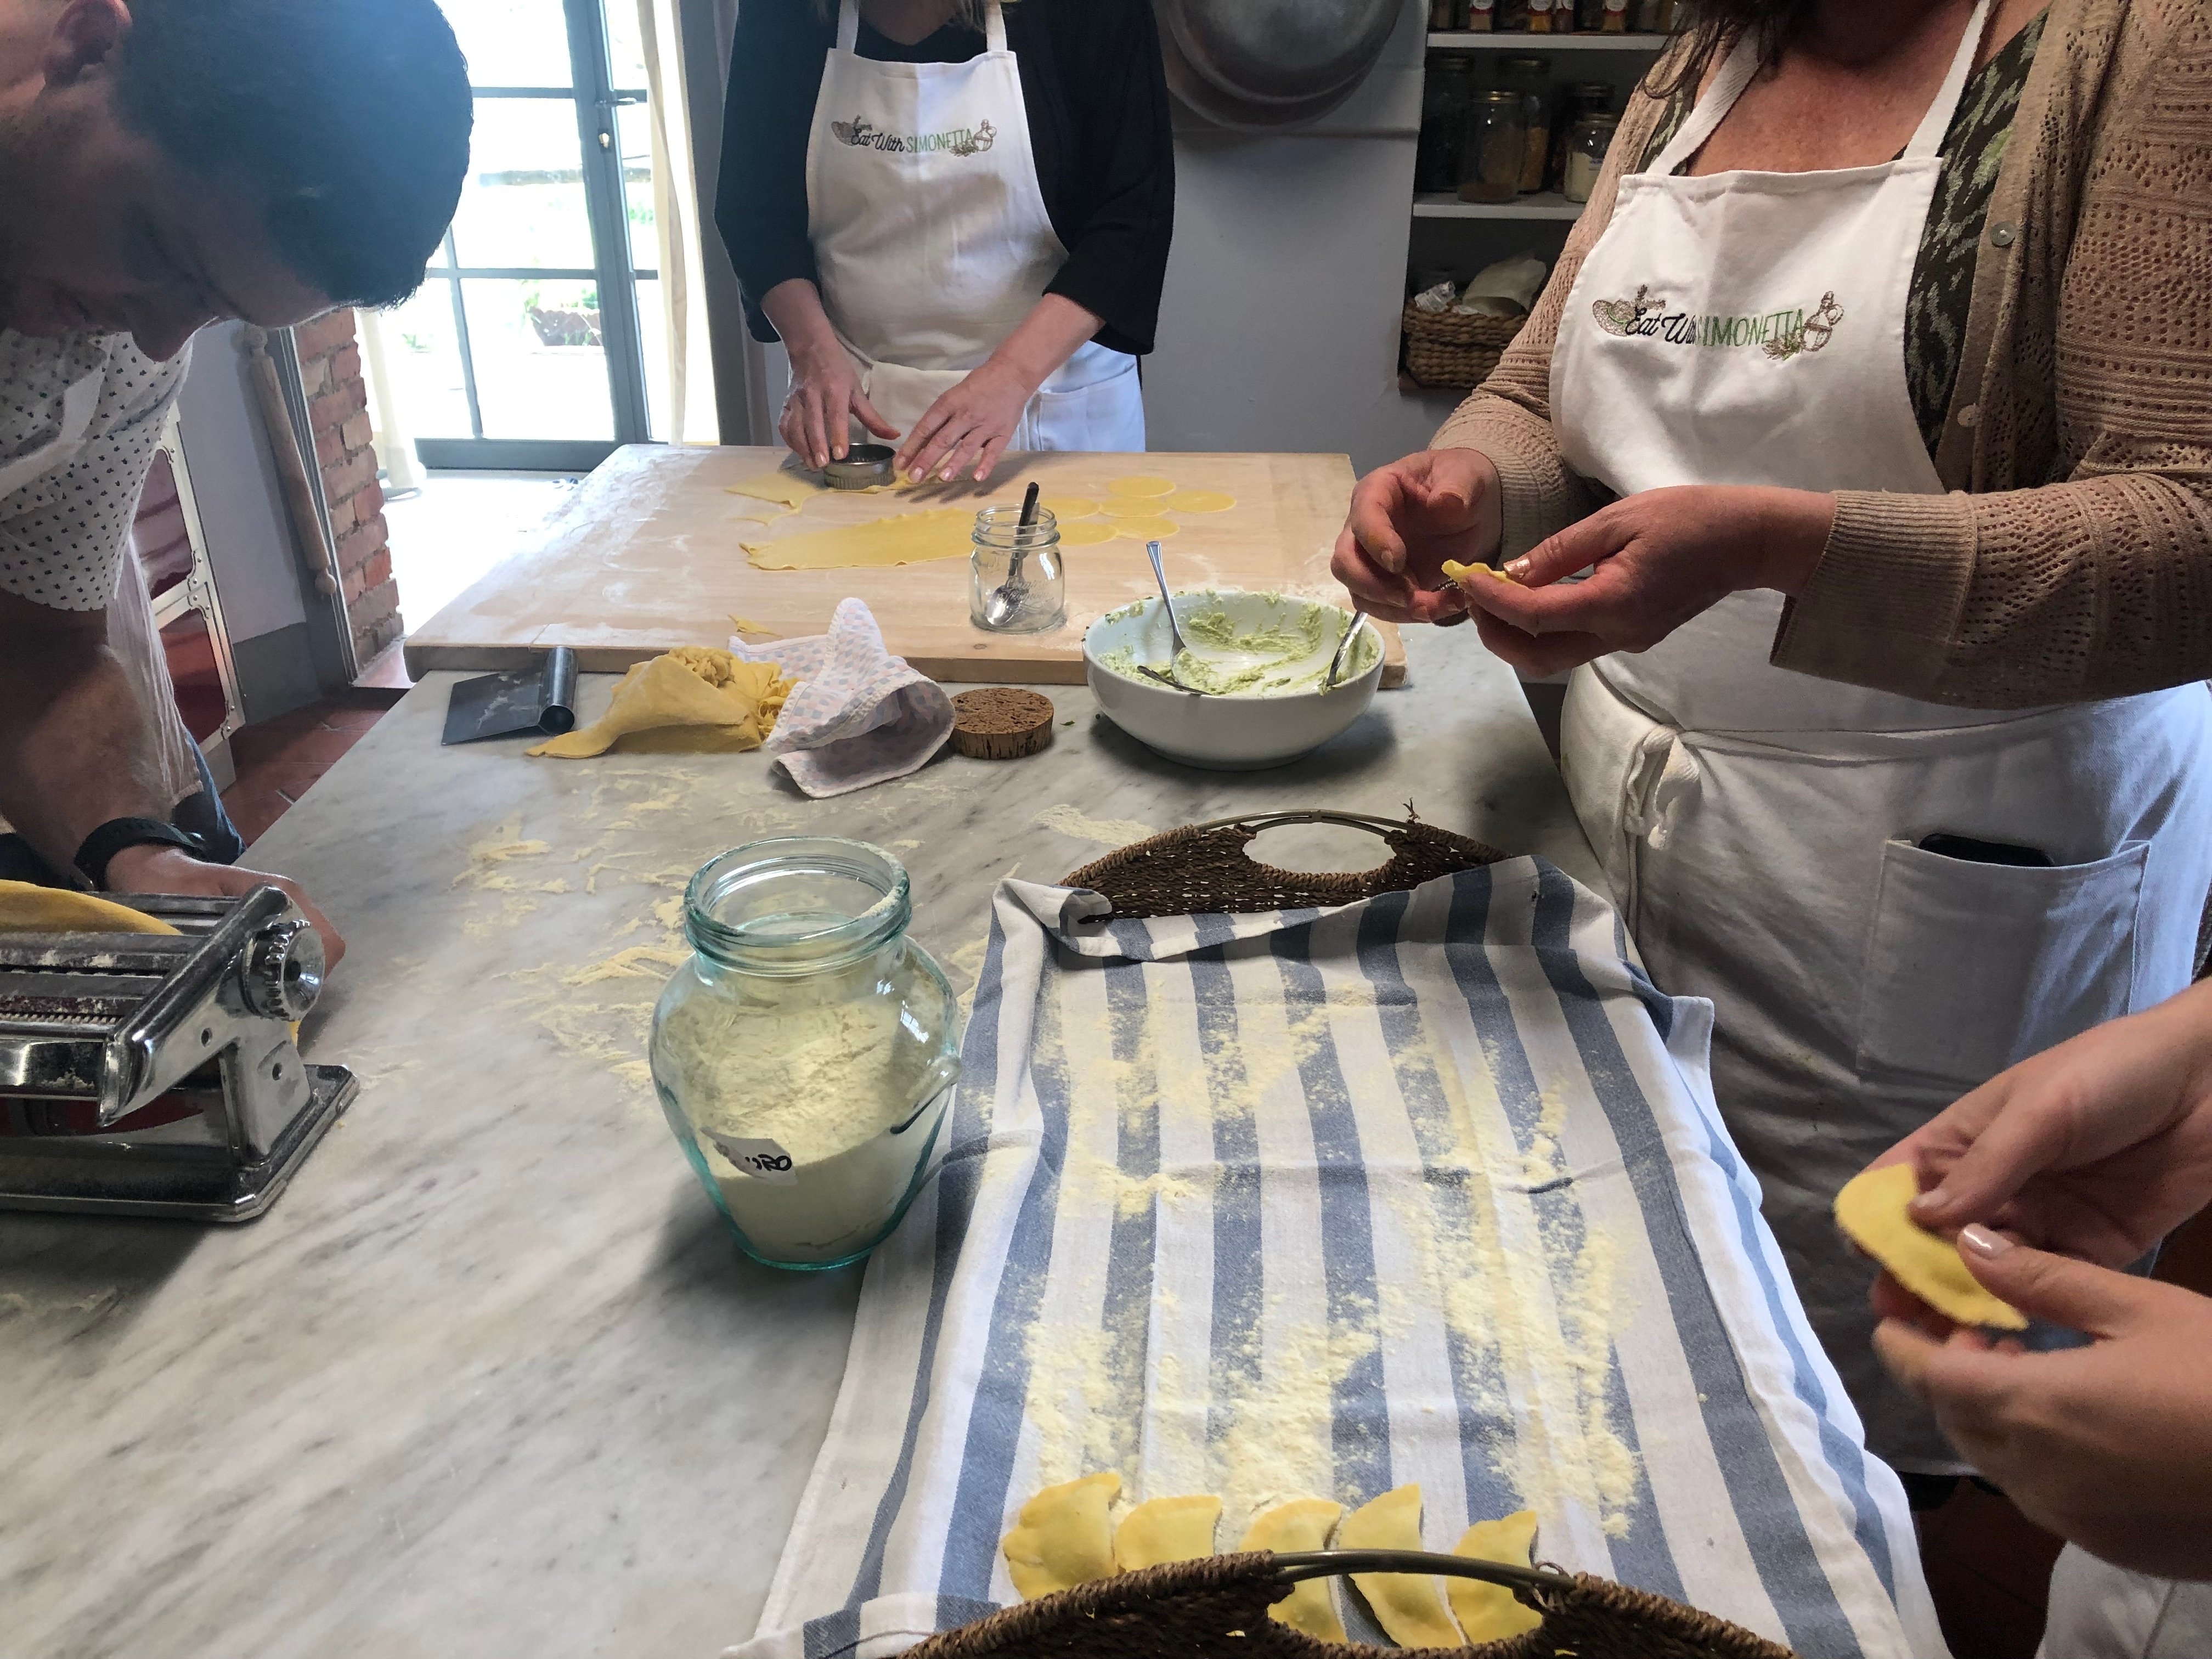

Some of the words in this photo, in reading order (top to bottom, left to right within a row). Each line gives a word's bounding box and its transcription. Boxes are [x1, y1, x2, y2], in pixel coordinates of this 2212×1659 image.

[851, 127, 871, 146] Eat
[871, 133, 905, 152] With
[906, 128, 973, 153] SIMONETTA
[1625, 306, 1661, 336] Eat
[1696, 309, 1803, 347] IMONETTA
